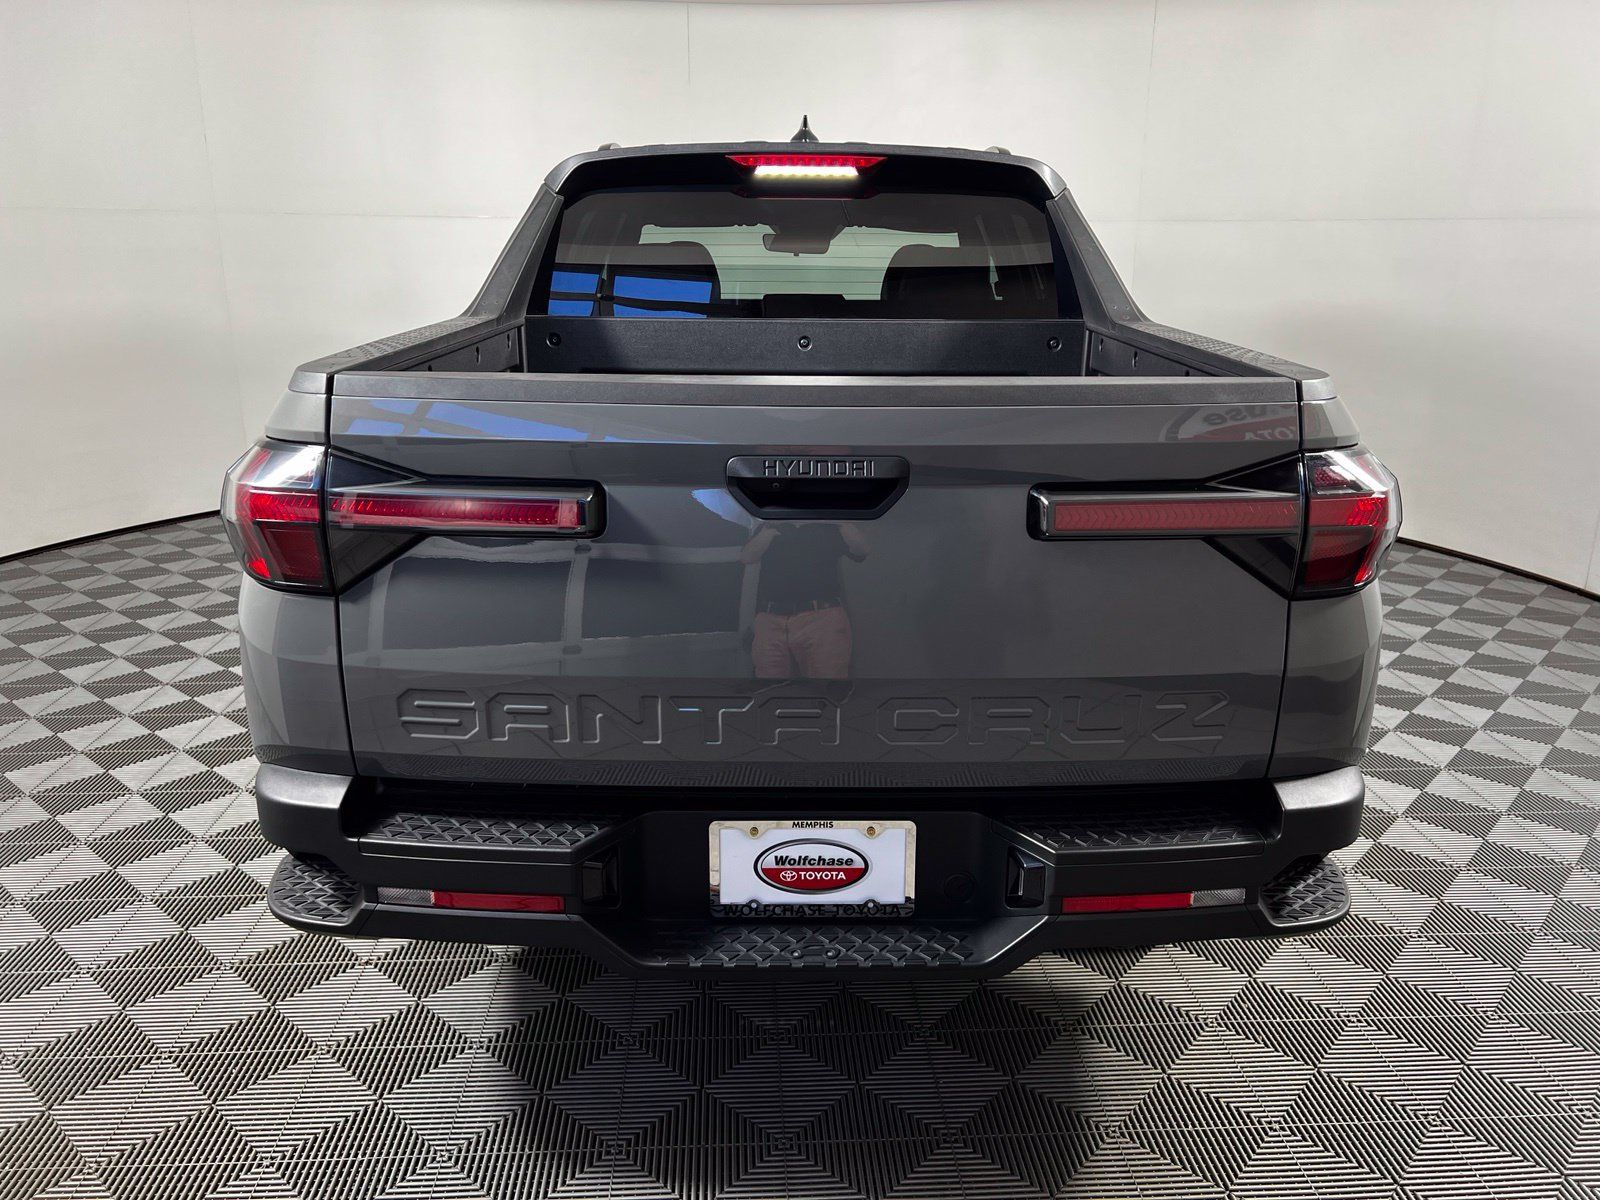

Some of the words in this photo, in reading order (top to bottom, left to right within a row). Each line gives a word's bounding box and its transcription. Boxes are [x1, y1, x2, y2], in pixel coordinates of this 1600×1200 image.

[763, 459, 875, 477] HYUNDAI
[397, 688, 841, 745] SANTA
[876, 690, 1231, 746] CRUZ
[791, 820, 834, 829] MEMPHIS
[774, 855, 854, 867] Wolfchase
[799, 871, 847, 880] TOYOTA
[723, 904, 826, 917] WOLFCHASE
[834, 904, 901, 917] TOYOTA
